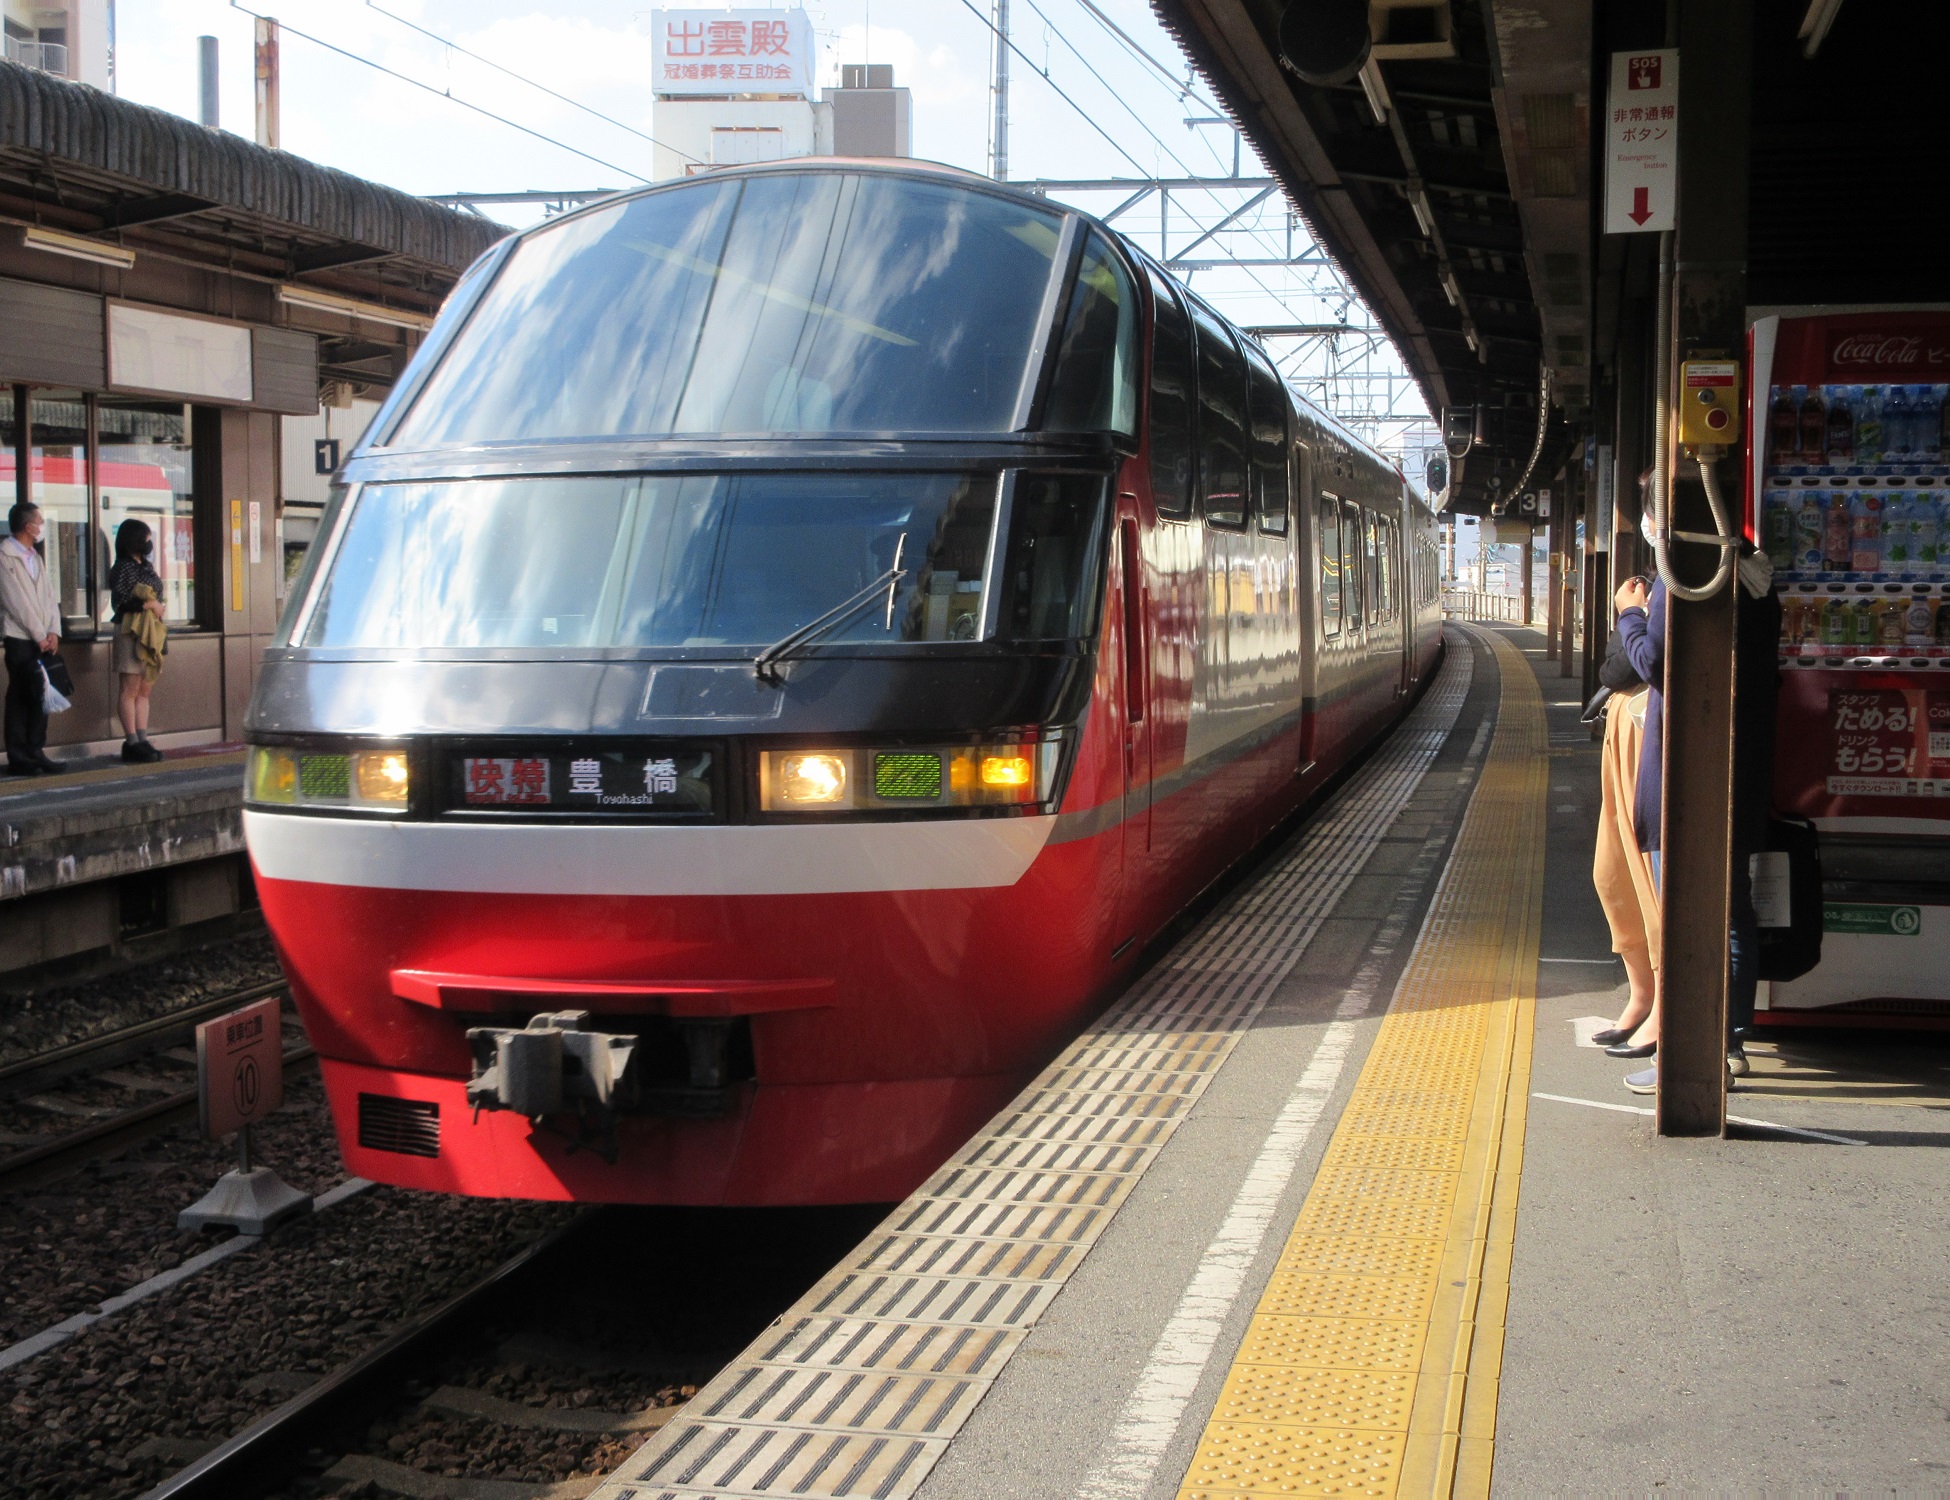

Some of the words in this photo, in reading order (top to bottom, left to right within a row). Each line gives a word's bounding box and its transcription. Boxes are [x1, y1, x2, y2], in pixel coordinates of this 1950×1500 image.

[666, 20, 791, 57] 出雲殿
[663, 63, 792, 80] 冠婚葬祭互助会
[1632, 57, 1658, 69] SOS
[1613, 105, 1675, 123] 非常通報
[1622, 128, 1668, 143] ボタン
[1617, 154, 1657, 163] Emergency
[319, 444, 331, 469] 1
[1522, 493, 1537, 511] 3
[1838, 694, 1880, 705] スタンプ
[1834, 706, 1918, 732] ためる!
[1838, 735, 1879, 746] ドリンク
[1835, 746, 1918, 774] もらう!
[471, 758, 546, 794] 快特
[595, 793, 654, 805] Toyohashi
[236, 1063, 256, 1107] 10
